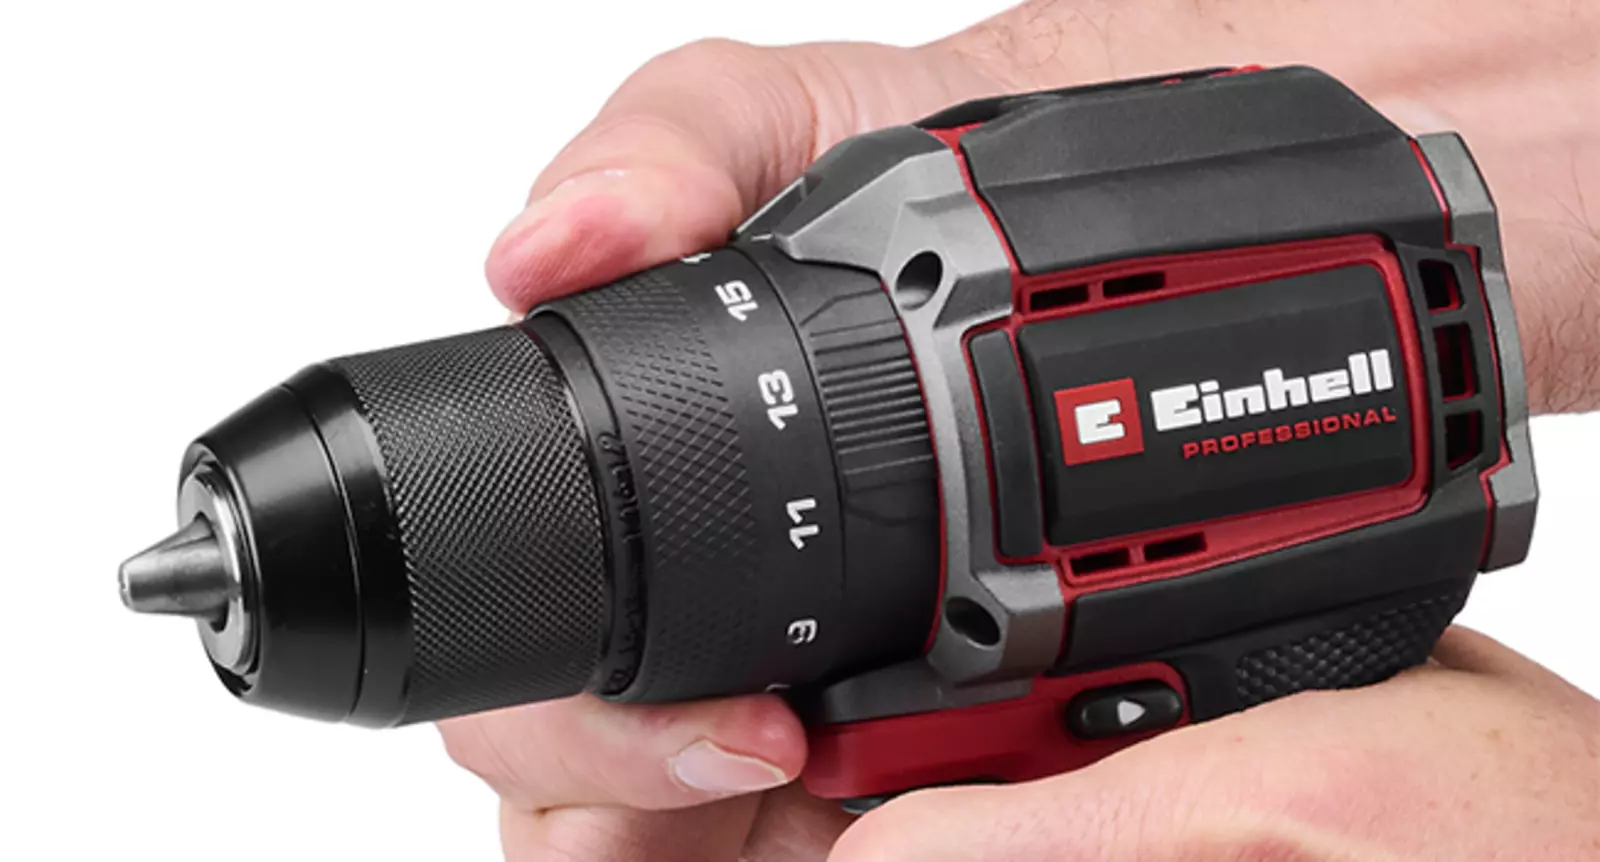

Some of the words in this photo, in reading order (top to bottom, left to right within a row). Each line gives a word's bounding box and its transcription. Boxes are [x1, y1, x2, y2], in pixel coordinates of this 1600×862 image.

[714, 280, 758, 321] 15
[758, 369, 798, 430] 13
[1150, 349, 1394, 431] Einhell
[1183, 407, 1396, 459] PROFESSIONAL
[787, 498, 819, 549] 11
